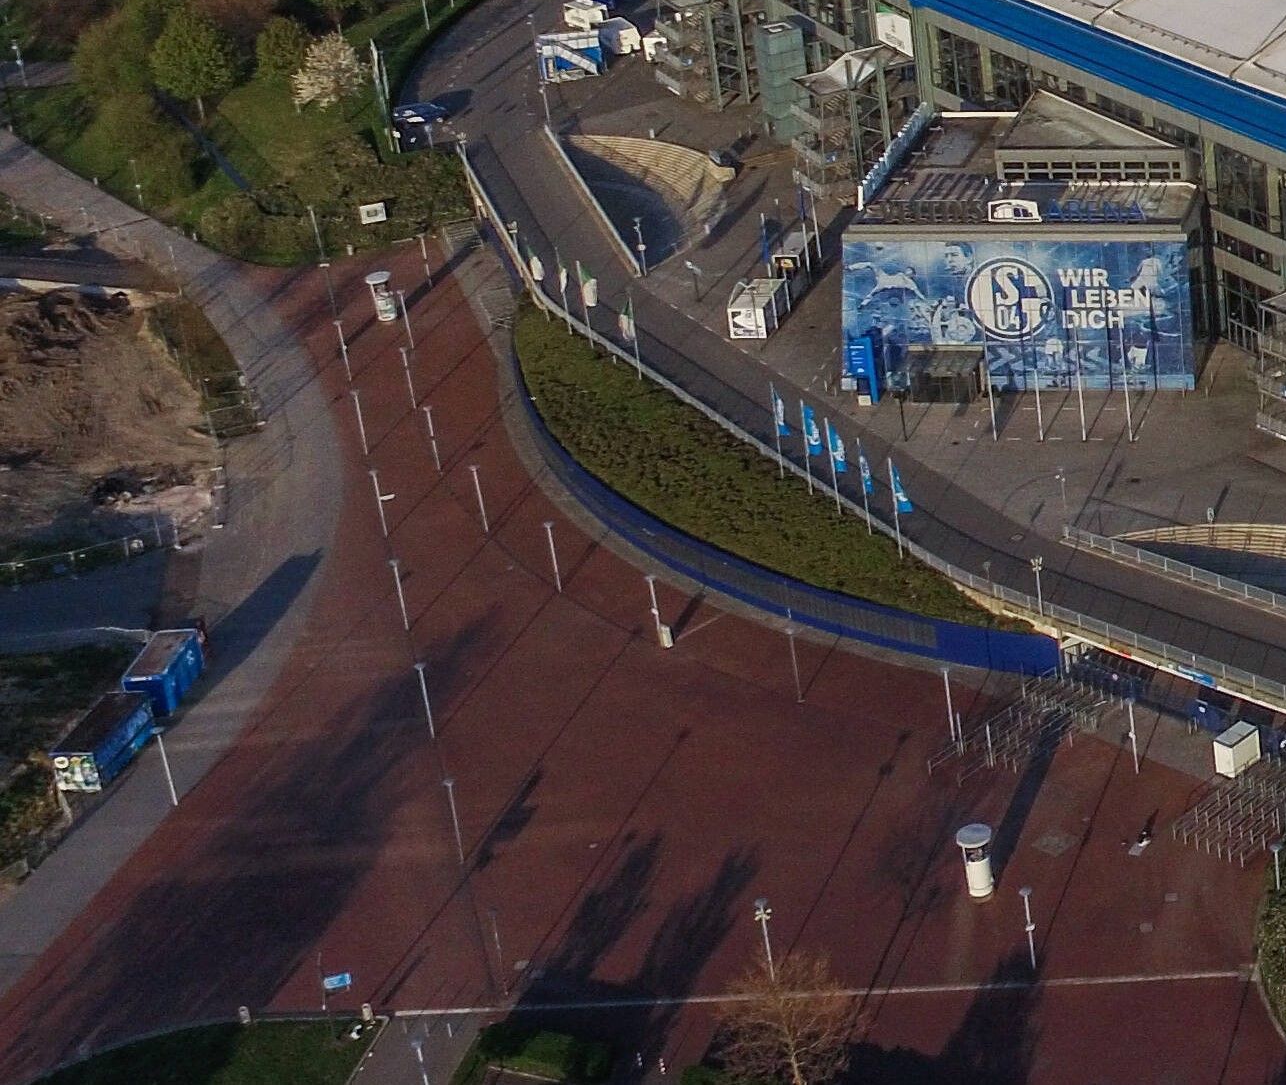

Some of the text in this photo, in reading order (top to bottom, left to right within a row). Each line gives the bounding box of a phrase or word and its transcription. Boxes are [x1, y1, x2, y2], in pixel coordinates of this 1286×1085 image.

[1057, 268, 1109, 287] WIR
[1071, 289, 1150, 308] LEBEN
[1061, 309, 1124, 329] DICH
